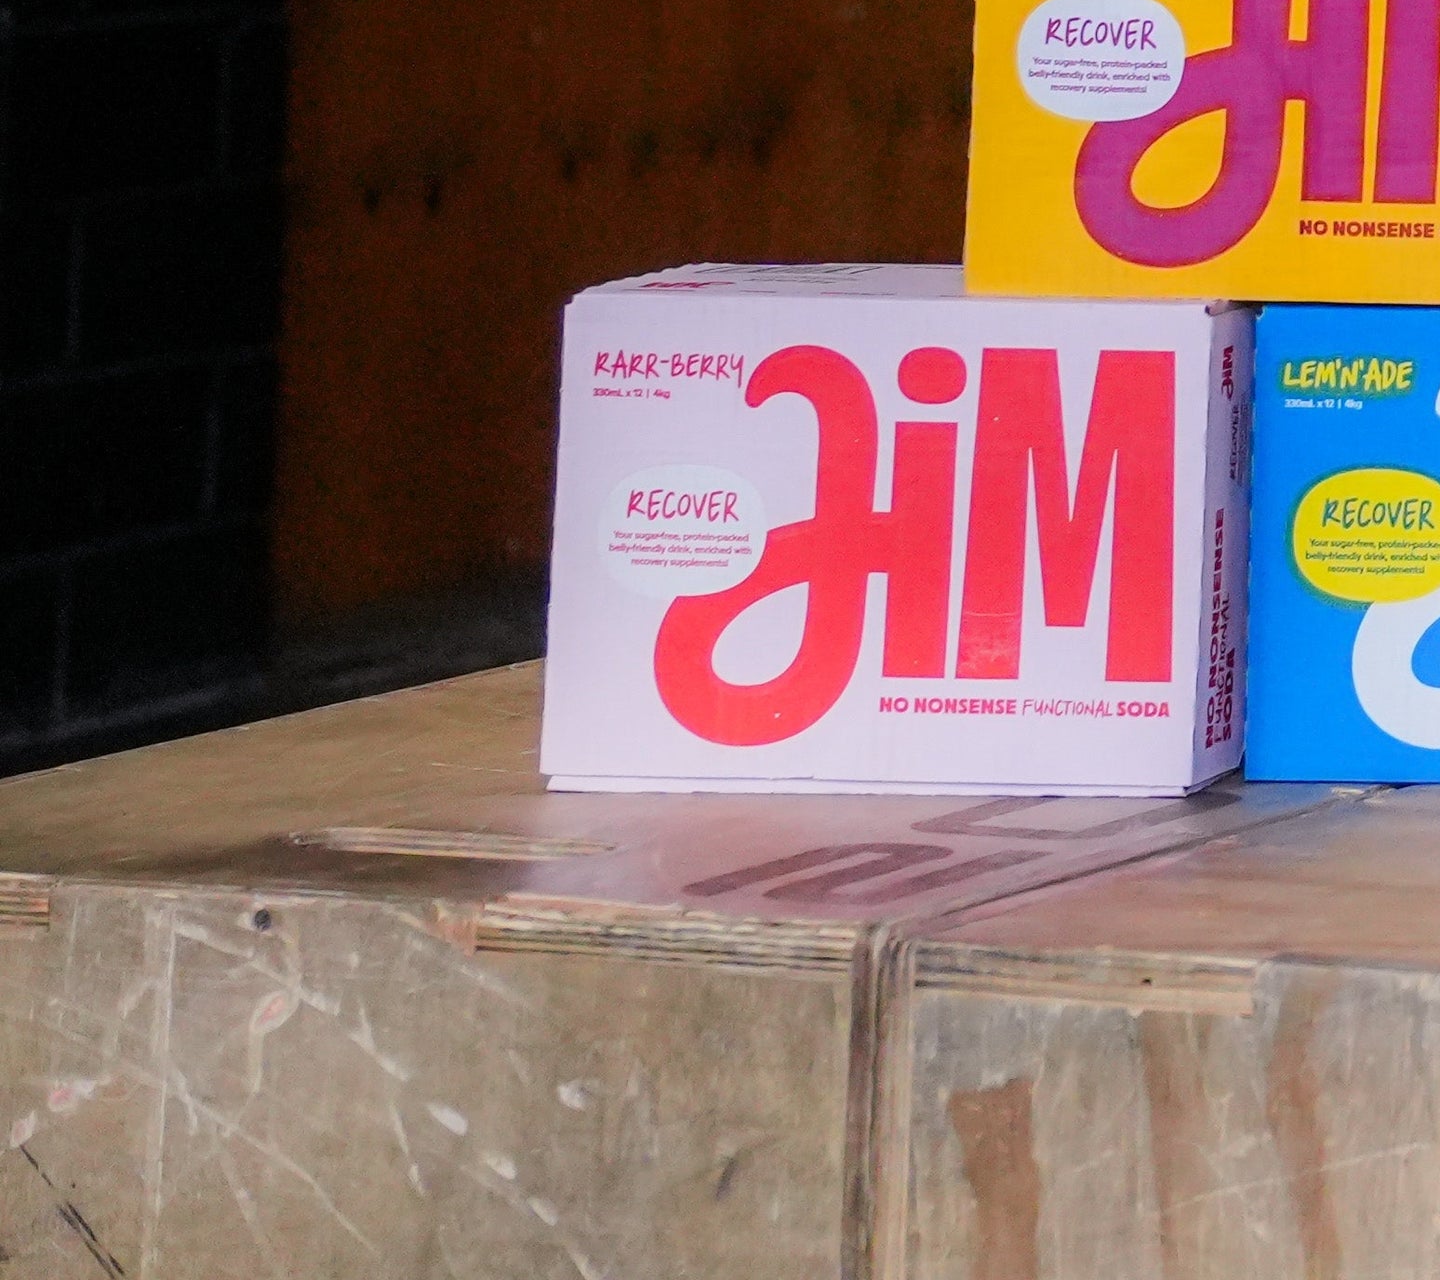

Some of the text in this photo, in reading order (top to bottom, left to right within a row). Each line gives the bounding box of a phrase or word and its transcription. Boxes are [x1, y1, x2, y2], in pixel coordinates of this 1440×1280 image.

[1045, 17, 1157, 51] RECOVER
[1300, 220, 1328, 236] NO
[1333, 221, 1434, 238] NONSENSE
[594, 349, 744, 389] RARR-BERRY
[1283, 358, 1413, 392] LEM'N'ADE
[627, 489, 739, 523] RECOVER
[1321, 498, 1435, 531] RECOVER
[1205, 508, 1225, 749] NO NONSENSE
[880, 697, 1170, 718] NO NONSENSE FUNCTIONAL SODA
[1223, 648, 1236, 740] SODA
